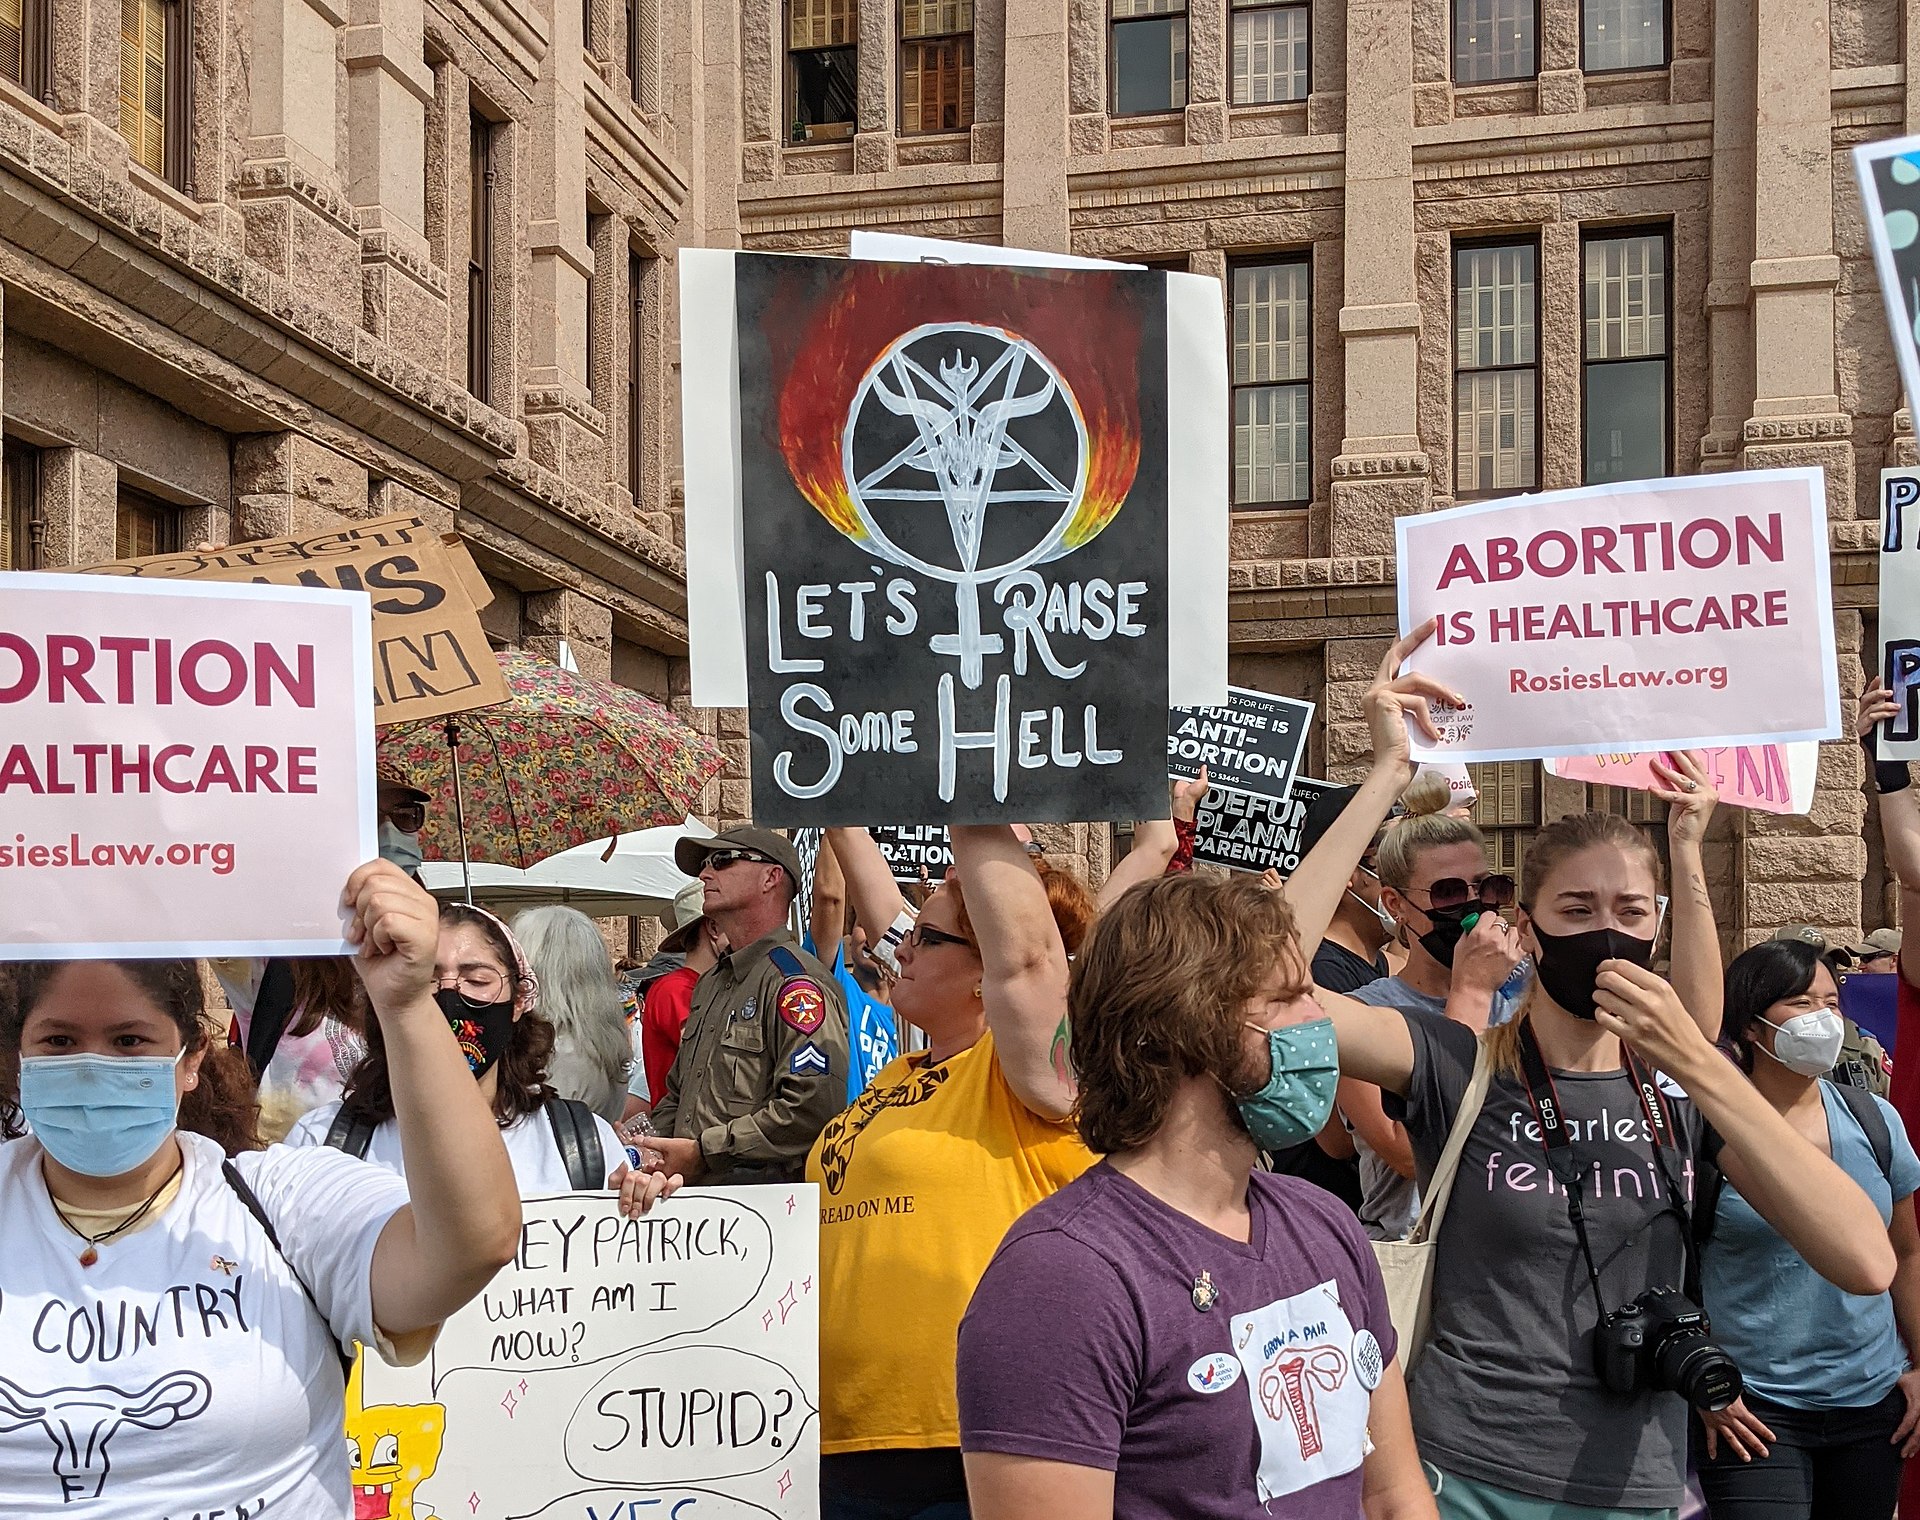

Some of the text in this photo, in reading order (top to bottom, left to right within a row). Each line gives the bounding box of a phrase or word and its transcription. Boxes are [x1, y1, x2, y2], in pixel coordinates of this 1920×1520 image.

[1435, 512, 1784, 590] ABORTION
[765, 565, 1149, 679] LET'S RAISE
[1436, 590, 1789, 646] IS HEALTHCARE
[1509, 664, 1729, 694] RosiesLaw.org
[1198, 706, 1268, 730] FUTURE
[1271, 719, 1289, 735] IS
[1239, 698, 1257, 709] FOR
[1257, 702, 1275, 713] LIFE
[1457, 714, 1474, 722] LAW
[773, 673, 1123, 803] SOME HELL
[1176, 717, 1258, 747] ANTI-
[0, 743, 318, 795] ALTHCARE
[1175, 763, 1192, 775] TEXT
[1539, 1098, 1558, 1130] EOS
[1642, 1082, 1664, 1129] Canon
[820, 1195, 915, 1224] READ ON ME
[593, 1216, 748, 1268] PATRICK,
[32, 1274, 249, 1364] COUNTRY
[484, 1281, 678, 1322] WHAT AM I
[1678, 1315, 1700, 1324] Canon
[491, 1321, 586, 1363] NOW?
[1263, 1321, 1328, 1360] GROW A PAIR
[1364, 1341, 1379, 1373] TEXAS
[1367, 1334, 1382, 1363] ELECT
[1359, 1347, 1377, 1386] WOMEN
[593, 1387, 793, 1452] STUPID?
